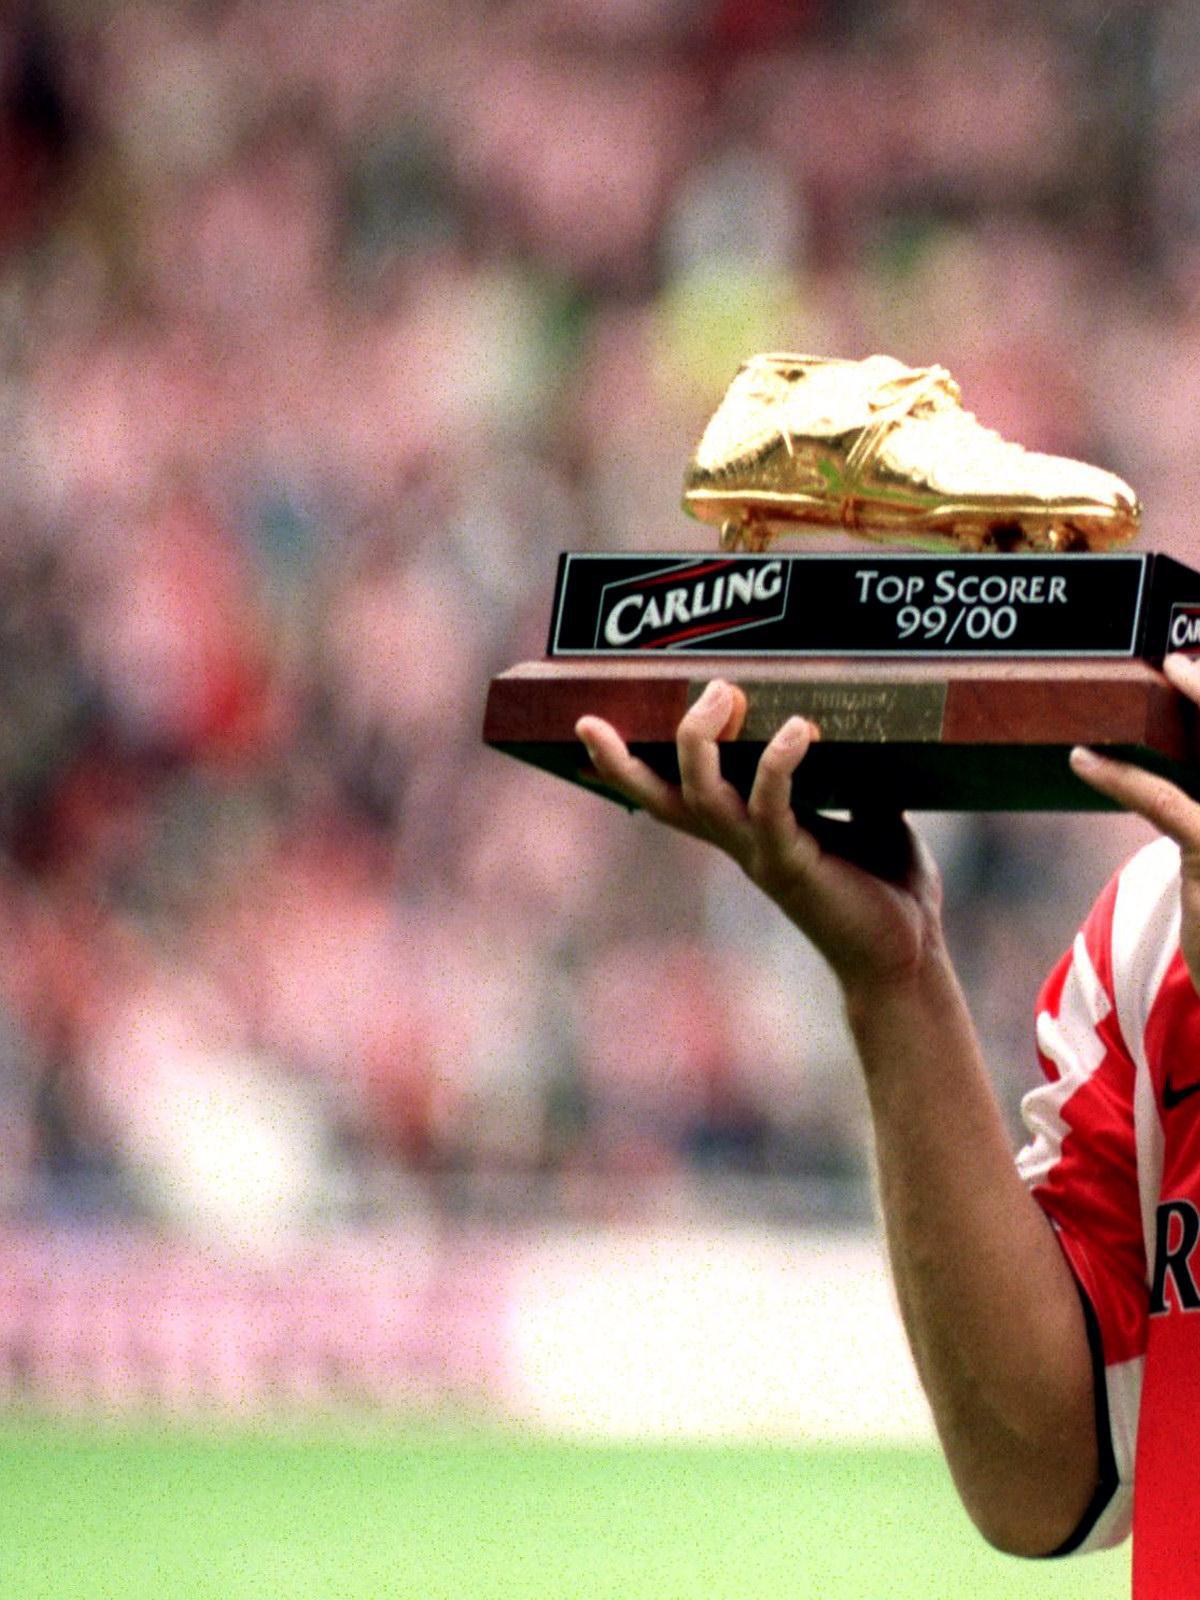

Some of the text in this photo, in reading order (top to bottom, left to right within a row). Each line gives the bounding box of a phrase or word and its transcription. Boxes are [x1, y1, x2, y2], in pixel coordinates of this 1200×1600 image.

[602, 561, 783, 647] CARLING
[855, 570, 1068, 604] TOP SCORER
[896, 605, 1017, 644] 99/00
